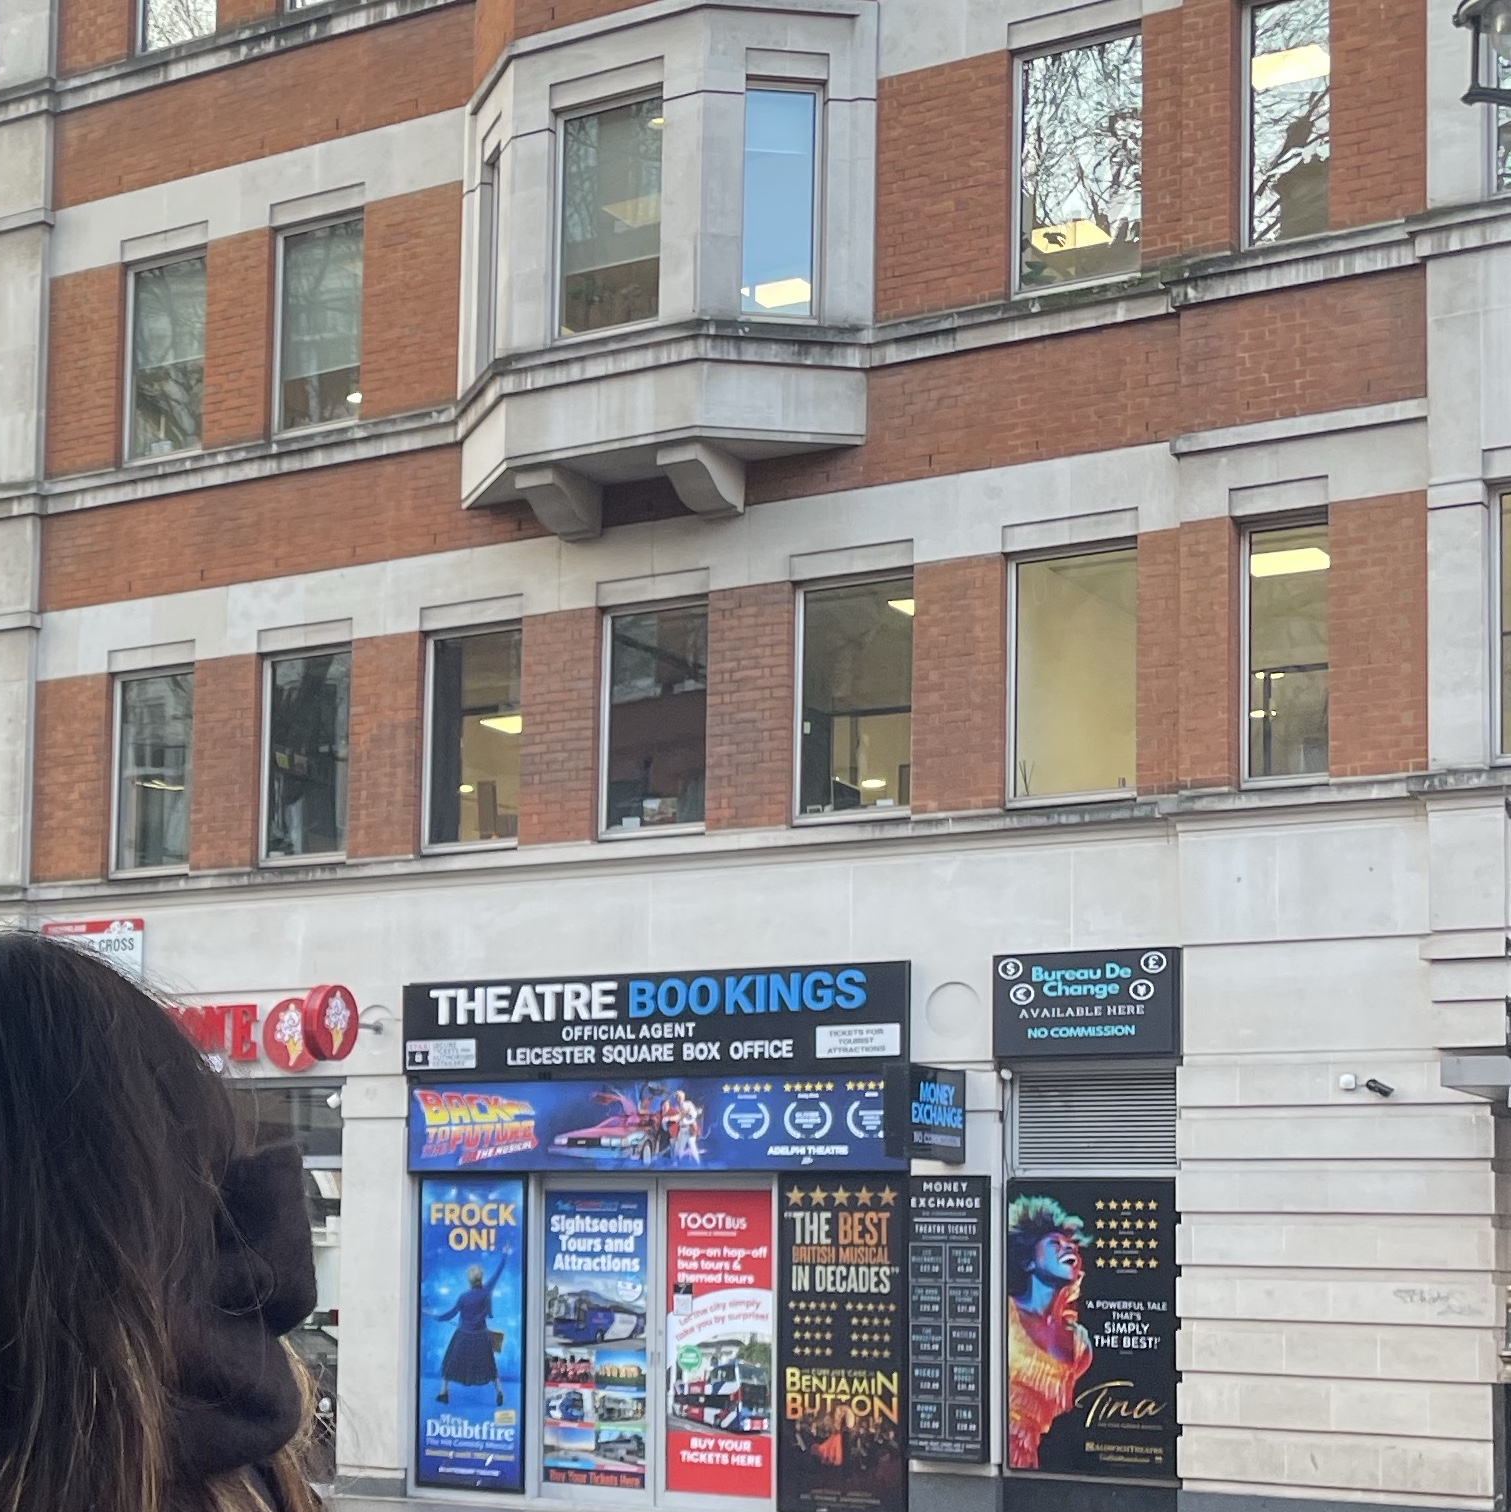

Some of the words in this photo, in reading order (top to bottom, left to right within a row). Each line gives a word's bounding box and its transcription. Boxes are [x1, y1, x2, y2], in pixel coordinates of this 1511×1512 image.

[99, 938, 135, 951] CROSS
[1031, 966, 1101, 982] Bureau
[1105, 963, 1132, 979] De
[429, 980, 619, 1026] THEATRE
[628, 969, 868, 1018] BOOKINGS
[1042, 981, 1120, 999] Change
[1019, 1006, 1102, 1019] AVAILABLE
[1107, 1005, 1145, 1016] HERE
[561, 1025, 636, 1042] OFFICIAL
[638, 1022, 696, 1039] AGENT
[1027, 1027, 1049, 1039] NO
[1050, 1024, 1136, 1038] COMMISSION
[507, 1046, 595, 1066] LEICESTER
[602, 1043, 674, 1064] SQUARE
[683, 1041, 720, 1061] BOX
[730, 1039, 793, 1060] OFFICE
[920, 1081, 955, 1106] MONEY
[413, 1089, 528, 1126] BACK
[912, 1101, 964, 1129] EXCHANGE
[449, 1120, 535, 1153] FUTURE
[922, 1181, 968, 1192] MONEY
[910, 1197, 981, 1208] EXCHANGE
[430, 1203, 516, 1226] FROCK
[550, 1214, 644, 1237] Sightseeing
[838, 1211, 891, 1246] BEST
[449, 1228, 496, 1251] ON!
[558, 1234, 602, 1252] Tours
[604, 1235, 635, 1253] and
[553, 1252, 641, 1273] Attractions
[677, 1245, 721, 1260] Hop-on
[723, 1246, 768, 1261] hop-off
[792, 1245, 835, 1265] BRITISH
[839, 1246, 891, 1265] MUSICAL
[677, 1259, 699, 1271] bus
[700, 1260, 730, 1271] tours
[731, 1260, 743, 1272] &
[677, 1272, 722, 1284] themed
[724, 1273, 755, 1285] tours
[792, 1265, 809, 1292] IN
[1095, 1301, 1144, 1311] POWERFUL
[1147, 1301, 1168, 1312] TALE
[1112, 1310, 1142, 1321] THAT'S
[1104, 1321, 1150, 1335] SIMPLY
[1093, 1334, 1119, 1348] THE
[785, 1366, 899, 1396] BENJAMIN
[786, 1392, 899, 1425] BUTTON
[1074, 1380, 1167, 1428] Tina
[425, 1418, 515, 1442] Doubtfire
[690, 1437, 716, 1450] BUY
[717, 1438, 752, 1452] YOUR
[680, 1450, 730, 1465] TICKETS
[731, 1454, 764, 1468] HERE
